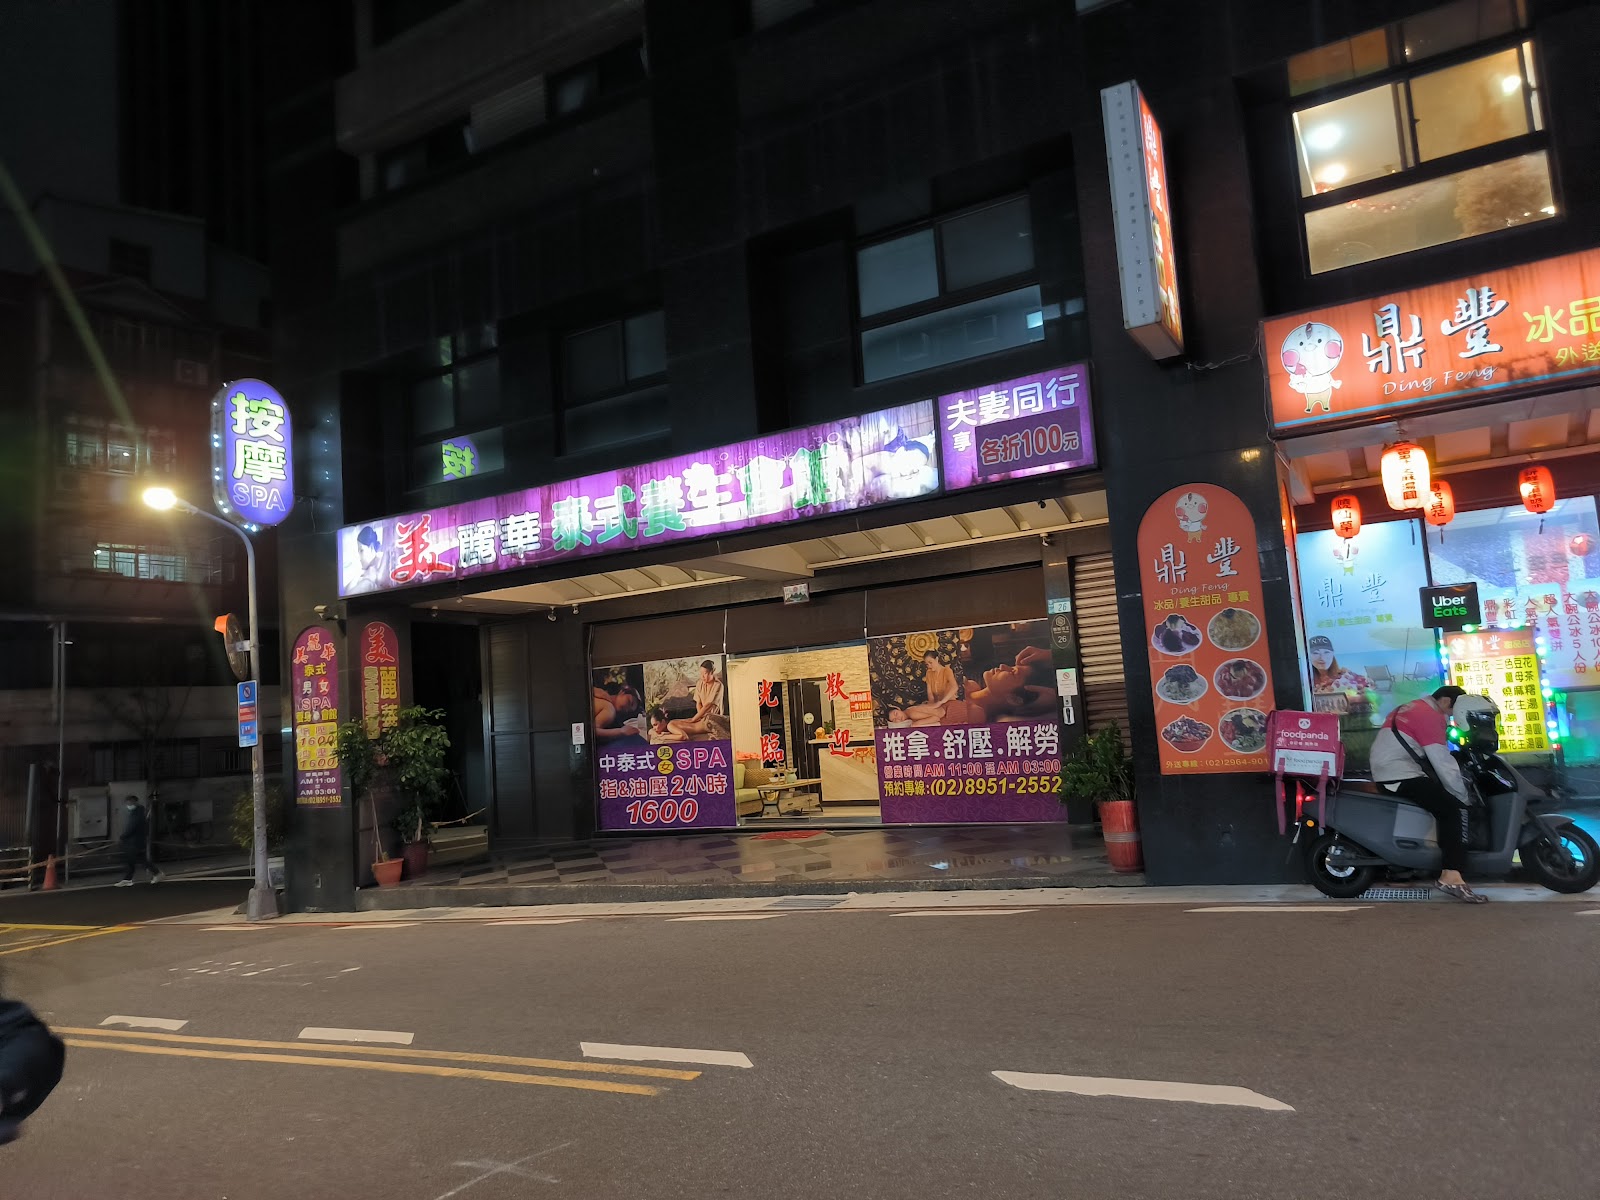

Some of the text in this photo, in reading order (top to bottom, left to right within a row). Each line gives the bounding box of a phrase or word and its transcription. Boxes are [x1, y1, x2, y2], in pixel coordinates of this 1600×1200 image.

[1522, 295, 1600, 343] 冰品
[1362, 285, 1509, 374] 鼎豐
[1555, 340, 1600, 367] 外送
[1382, 363, 1498, 396] Ding Feng
[947, 373, 1080, 431] 夫妻同行
[230, 391, 287, 485] 按摩
[952, 424, 1079, 465] 享 各折100元
[232, 482, 286, 512] SPA
[1154, 536, 1241, 584] 鼎豐
[1170, 582, 1230, 596] Ding Feng
[1058, 602, 1067, 612] 26
[1153, 593, 1222, 611] 冰品/養生甜品
[1431, 595, 1466, 607] Uber
[1433, 606, 1468, 618] Eats
[1057, 635, 1067, 644] 26
[1311, 637, 1328, 645] NYC
[304, 662, 327, 677] 泰式
[1495, 656, 1533, 670] 三色豆花
[302, 679, 329, 695] 男 女
[301, 696, 331, 710] SPA
[757, 678, 785, 763] 光臨
[824, 672, 855, 758] 歡迎
[1281, 729, 1329, 740] foodpanda
[300, 757, 335, 769] 1600
[599, 751, 656, 773] 中泰式
[676, 747, 727, 770] SPA
[924, 763, 945, 777] AM
[948, 762, 983, 777] 11:00
[997, 761, 1019, 775] AM
[1022, 759, 1061, 774] 03:00
[1205, 757, 1269, 767] (02)2964-901
[930, 775, 1062, 796] (02)8951-2552
[626, 798, 698, 824] 1600
